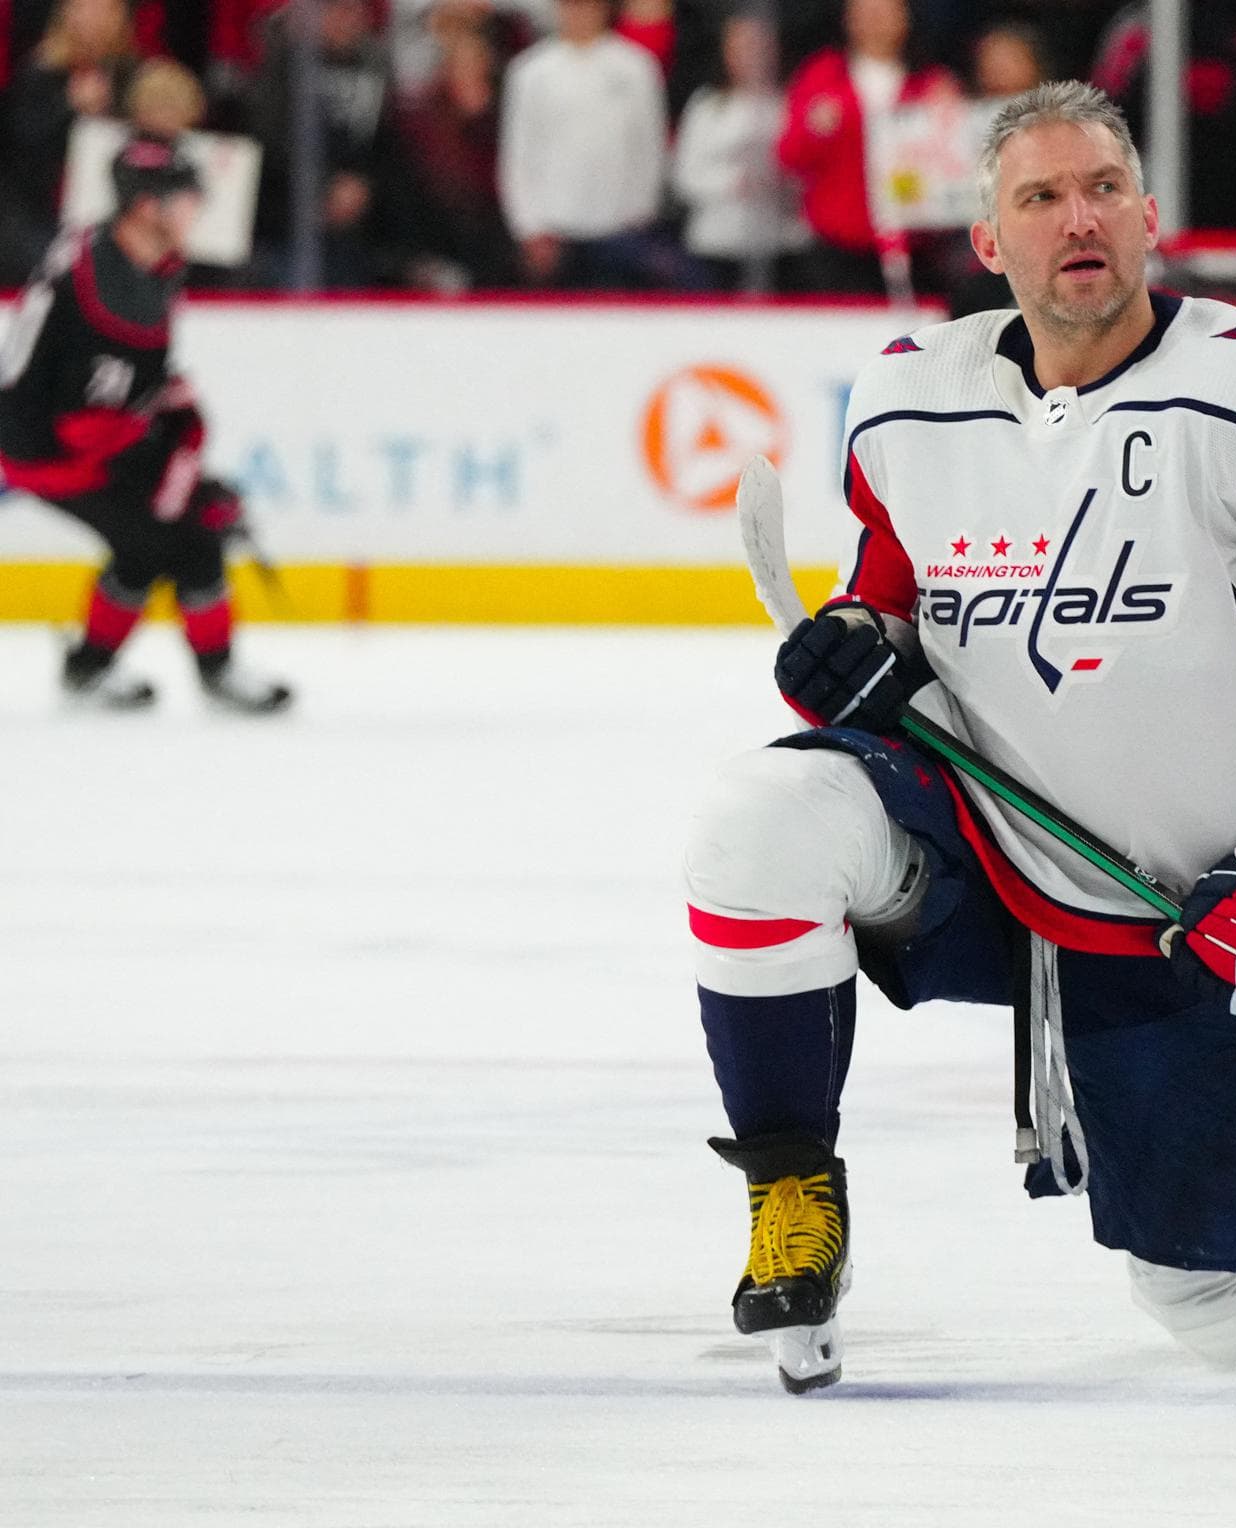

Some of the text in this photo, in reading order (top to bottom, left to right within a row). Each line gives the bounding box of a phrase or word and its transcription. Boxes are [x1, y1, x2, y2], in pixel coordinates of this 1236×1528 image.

[232, 439, 524, 514] ALTH
[1121, 430, 1153, 496] C
[926, 564, 1044, 579] WASHINGTON
